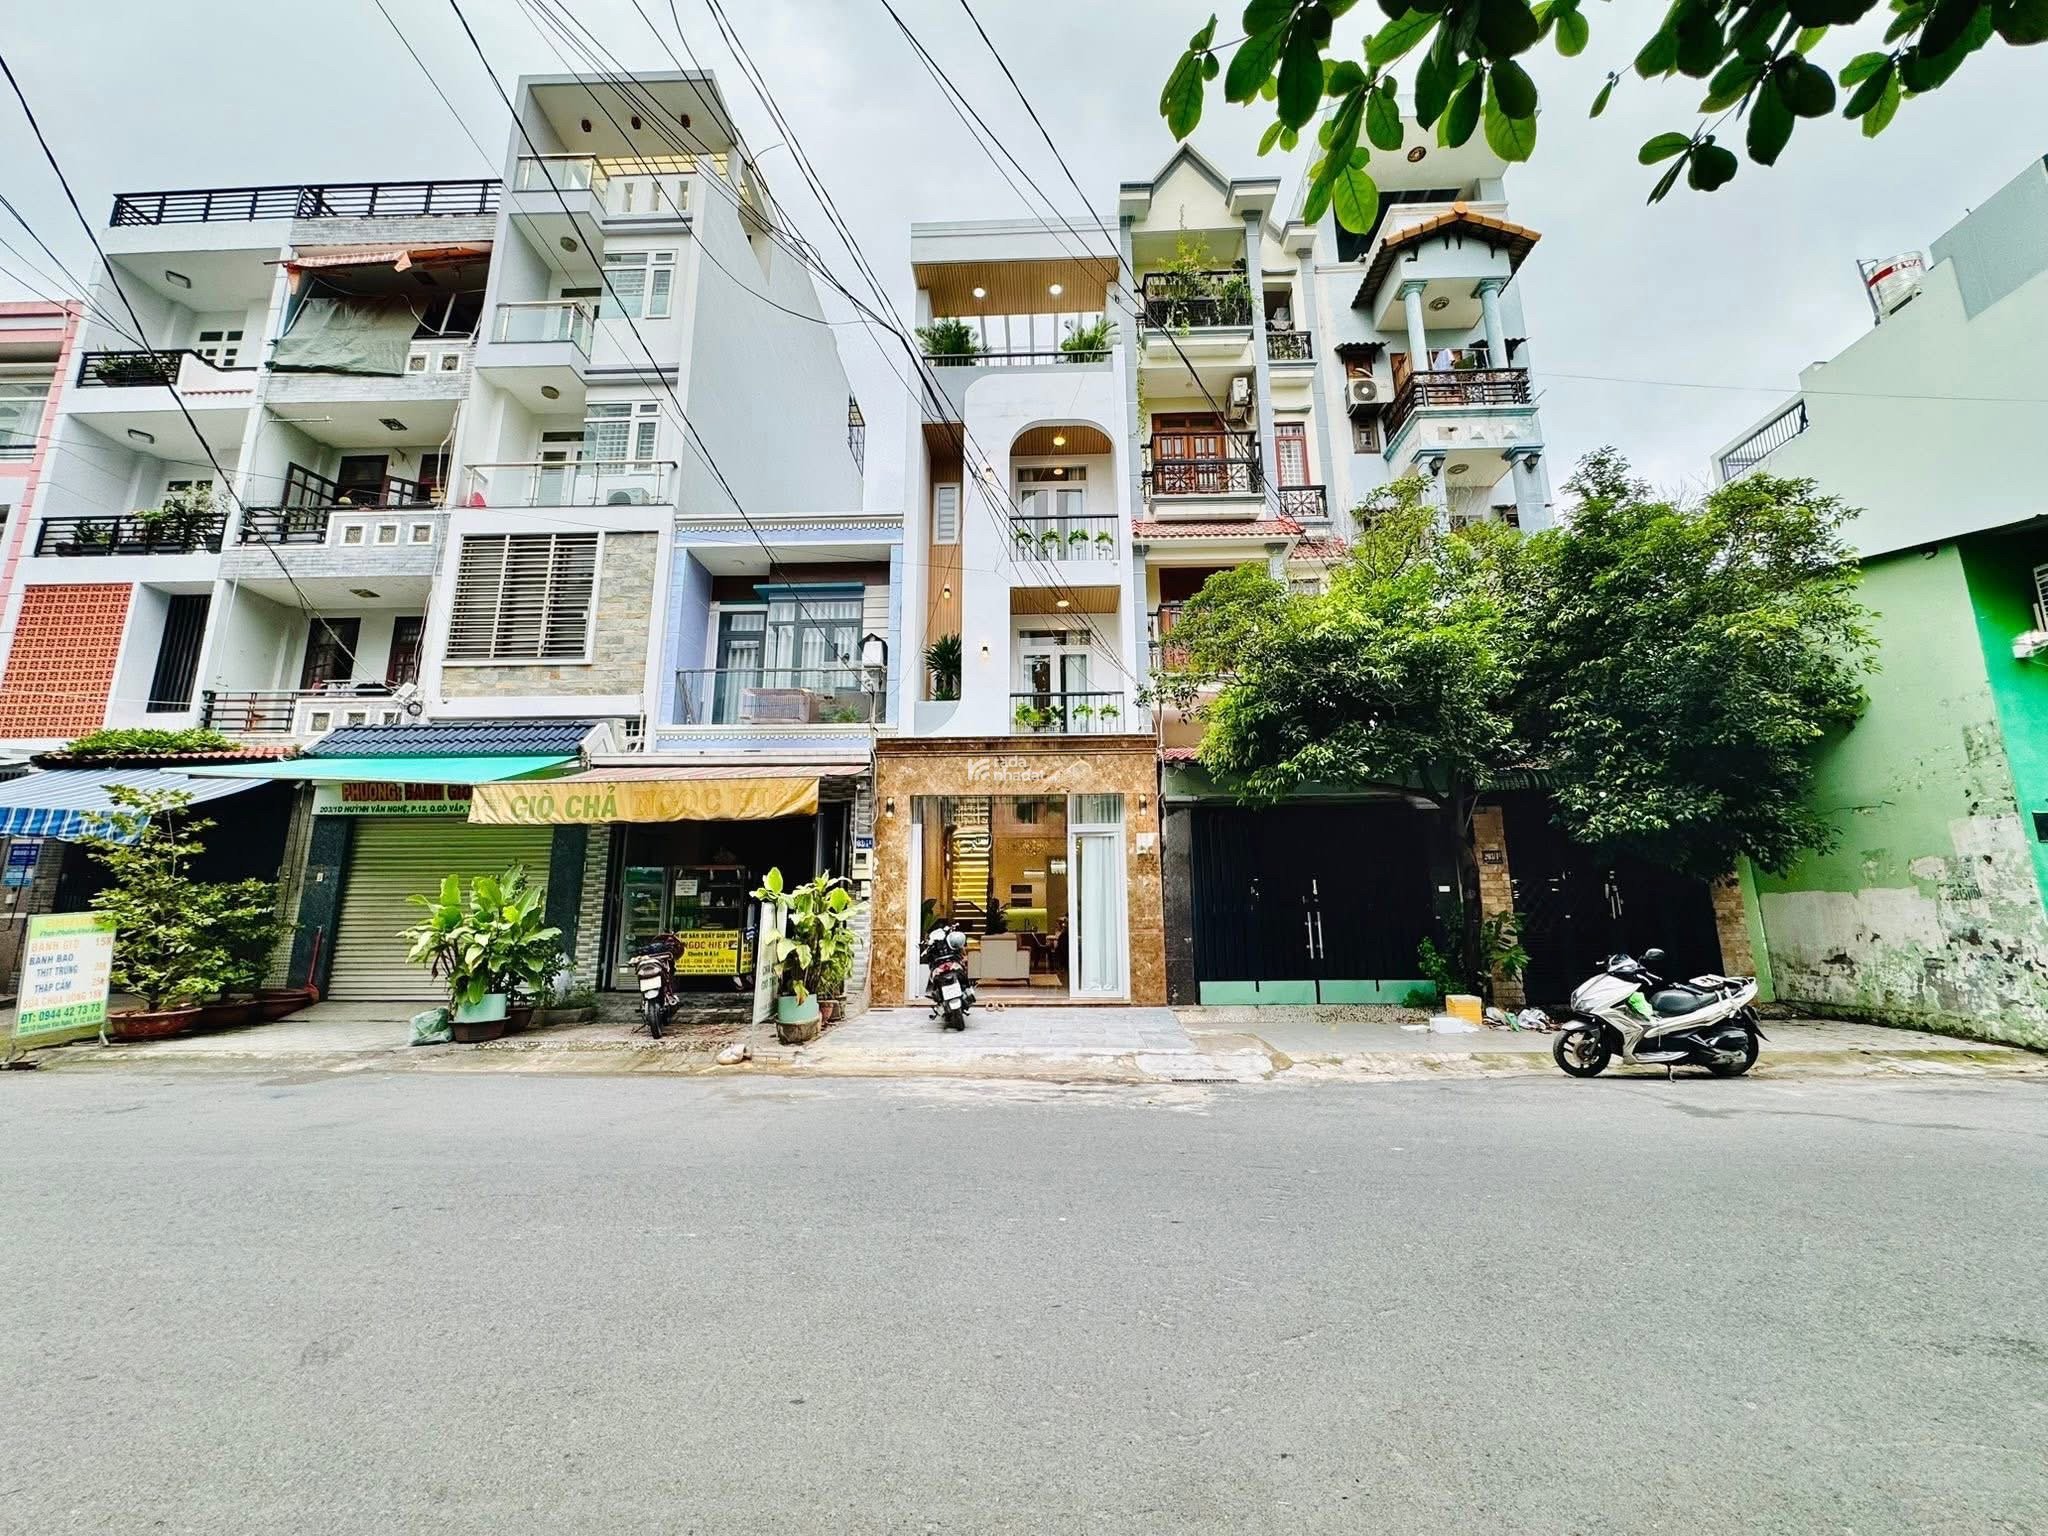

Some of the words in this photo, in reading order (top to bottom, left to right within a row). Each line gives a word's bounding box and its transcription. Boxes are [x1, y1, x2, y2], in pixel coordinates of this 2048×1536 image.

[511, 788, 555, 819] GIÒ
[564, 785, 618, 818] CHẢ
[39, 1009, 61, 1022] 0944
[64, 1006, 75, 1017] 42
[78, 1004, 88, 1015] 73
[91, 1003, 101, 1013] 73
